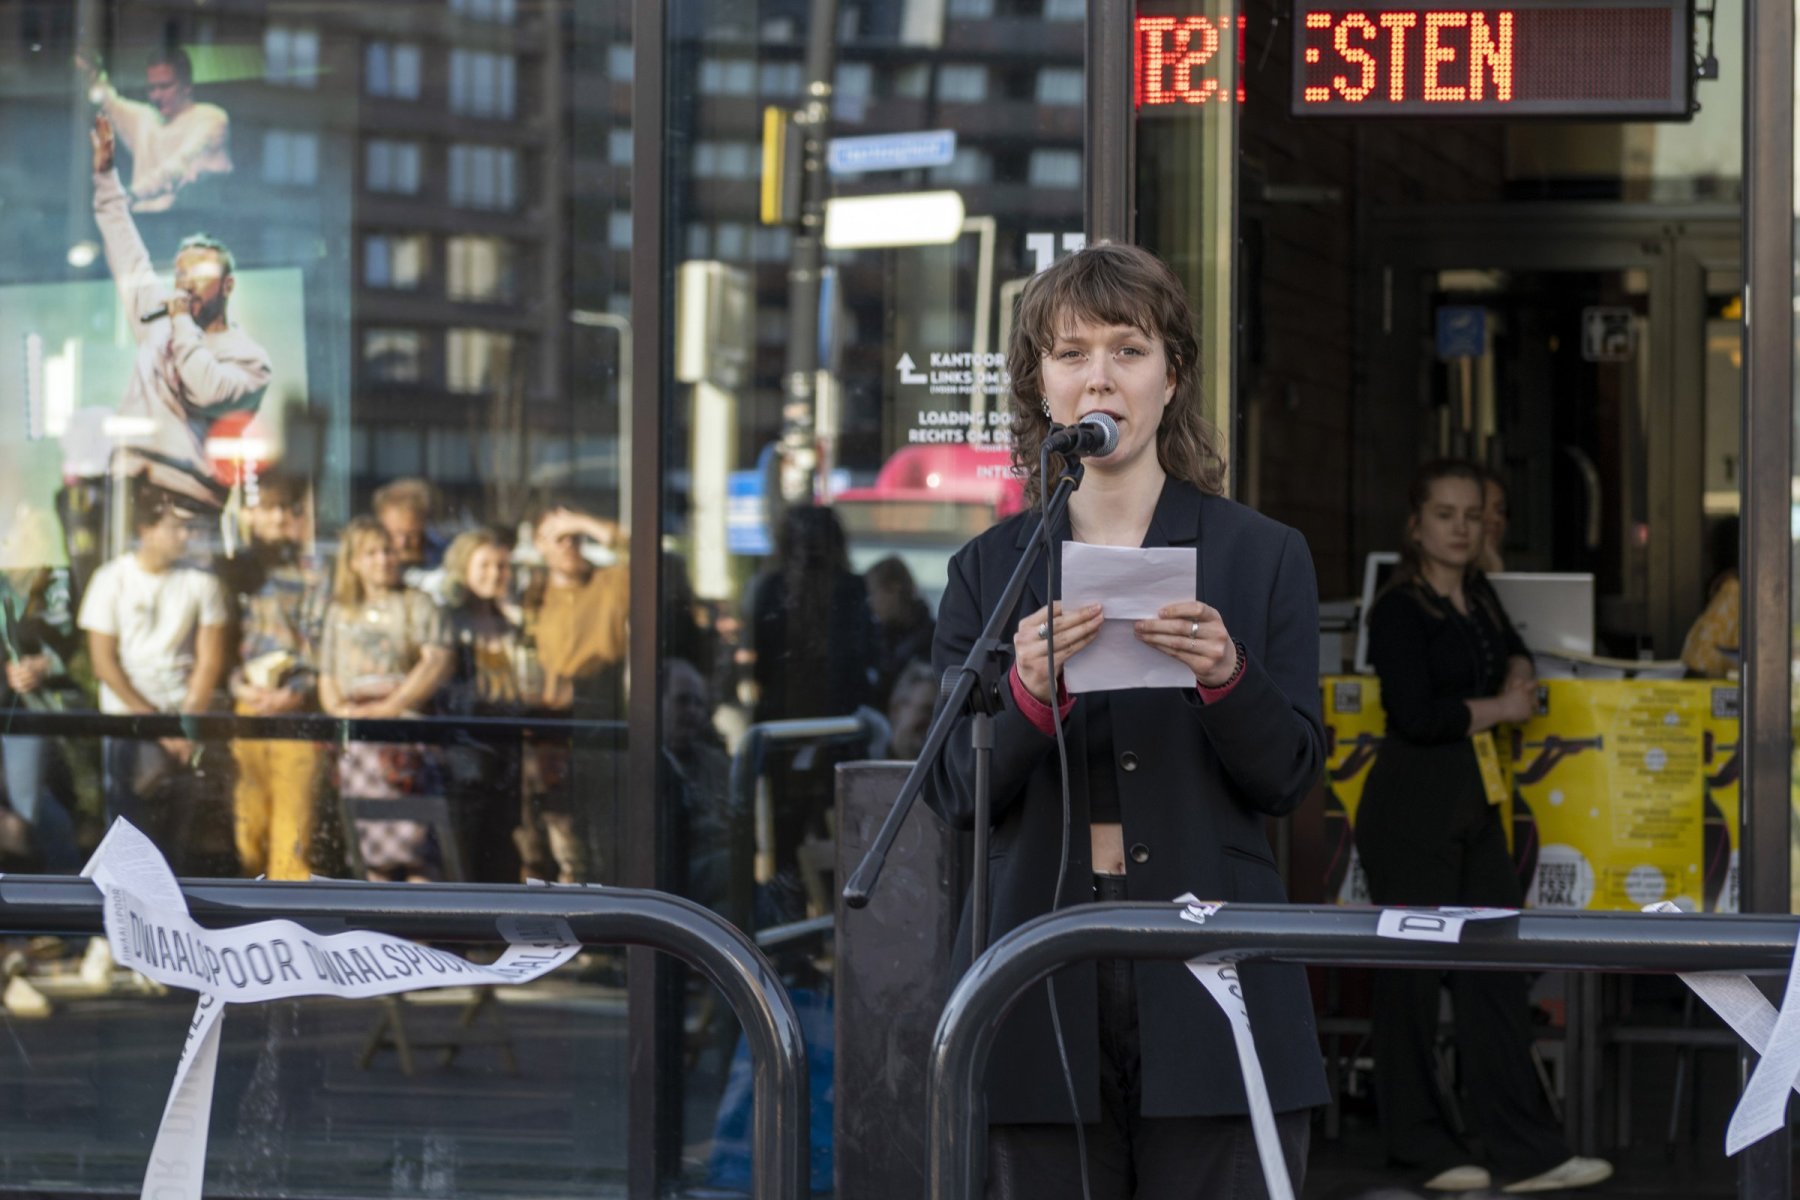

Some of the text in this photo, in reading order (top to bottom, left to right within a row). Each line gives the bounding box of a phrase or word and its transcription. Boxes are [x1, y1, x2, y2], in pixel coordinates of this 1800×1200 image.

[930, 352, 1005, 367] KANTOOR
[930, 371, 973, 385] LINKS
[976, 371, 999, 385] OM
[918, 411, 1015, 426] LOADING DO
[908, 428, 964, 443] RECHTS
[966, 428, 991, 443] OM
[130, 910, 302, 988] DWAALSPOOR
